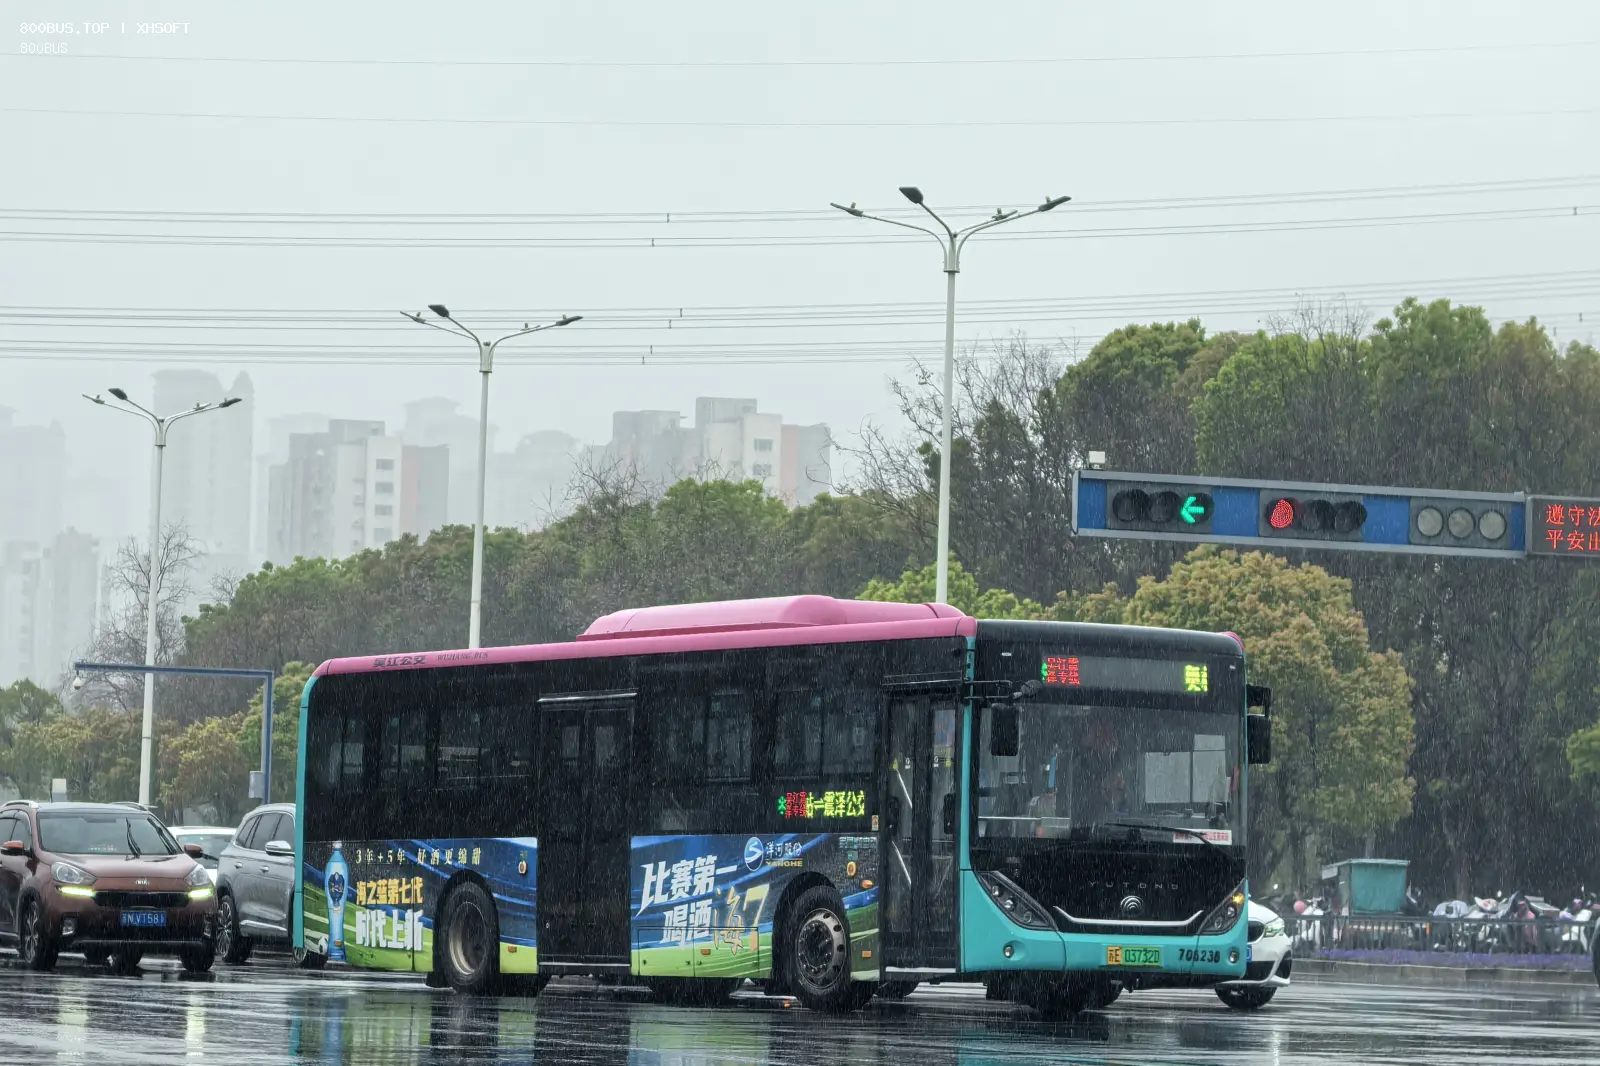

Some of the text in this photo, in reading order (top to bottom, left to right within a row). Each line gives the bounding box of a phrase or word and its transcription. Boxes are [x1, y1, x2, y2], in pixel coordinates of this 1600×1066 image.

[374, 655, 427, 668] 吴江公交
[356, 876, 424, 905] 海之蓝第七代
[635, 855, 738, 918] 比赛第一
[355, 908, 424, 952] 时代上新
